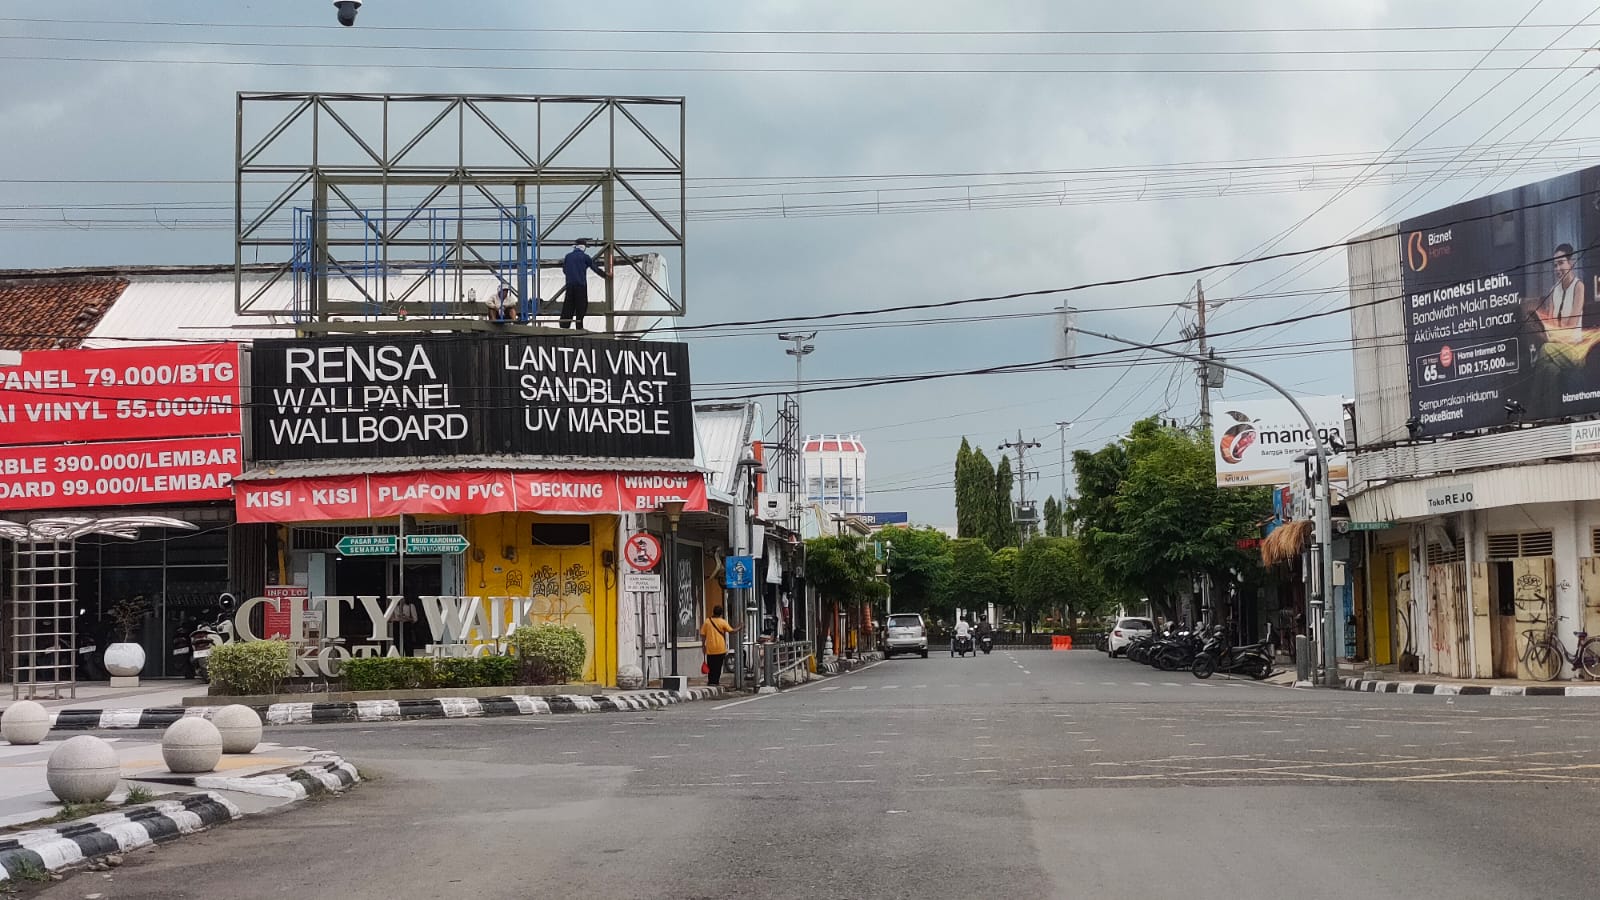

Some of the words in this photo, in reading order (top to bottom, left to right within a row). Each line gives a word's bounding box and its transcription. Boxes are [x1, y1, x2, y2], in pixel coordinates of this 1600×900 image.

[1428, 229, 1453, 246] Biznet
[1411, 291, 1431, 308] Beri
[1433, 280, 1475, 303] Koneksi
[1477, 273, 1512, 292] Lebih.
[1412, 304, 1459, 326] Bandwidth
[1460, 297, 1488, 315] Makin
[1489, 292, 1522, 309] Besar,
[1414, 325, 1451, 343] Aktivitas
[1452, 318, 1478, 335] Lebih
[1479, 312, 1516, 329] Lancar.
[285, 344, 437, 384] RENSA
[505, 344, 597, 372] LANTAI
[606, 349, 678, 377] VINYL
[1424, 365, 1438, 382] 65
[1458, 362, 1473, 375] IDR
[1473, 357, 1506, 373] 175,000
[84, 362, 234, 388] 79.000/BTG
[273, 384, 461, 415] WALLPANEL
[519, 375, 669, 406] SANDBLAST
[1466, 389, 1499, 404] Hidupmu
[24, 401, 108, 423] VINYL
[116, 395, 233, 419] 55.000/M
[524, 407, 561, 432] UV
[568, 408, 671, 436] MARBLE
[269, 414, 469, 445] WALLBOARD
[0, 457, 47, 475] BLE
[54, 448, 238, 473] 390.000/LEMBAR
[62, 472, 232, 496] 99.000/LEMBAR
[378, 484, 460, 503] PLAFON
[467, 483, 505, 500] PVC
[530, 482, 603, 499] DECKING
[624, 475, 688, 489] WINDOW
[246, 489, 292, 508] KISI
[312, 486, 358, 506] KISI
[1428, 498, 1445, 508] Toko
[1445, 491, 1473, 505] REJO
[862, 515, 876, 524] BRI
[267, 589, 288, 597] INFO
[235, 595, 404, 643] CITY
